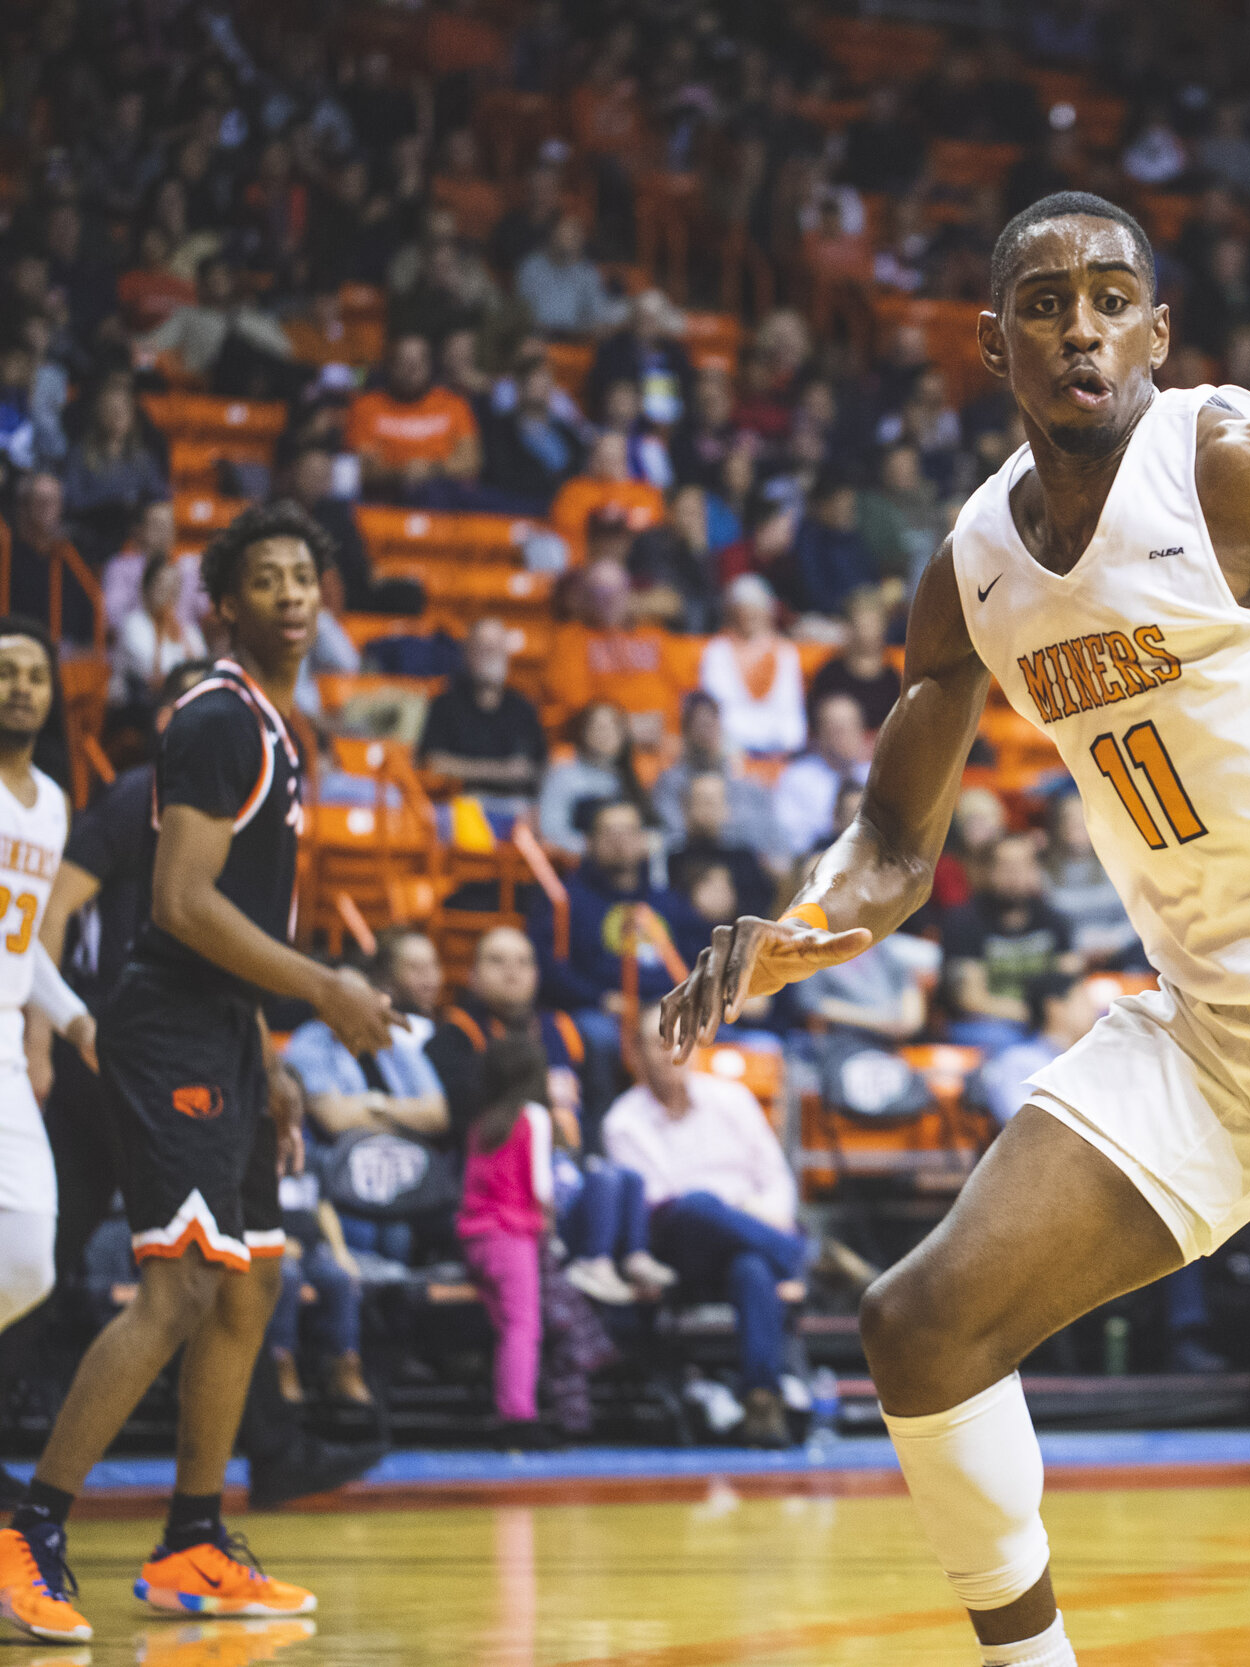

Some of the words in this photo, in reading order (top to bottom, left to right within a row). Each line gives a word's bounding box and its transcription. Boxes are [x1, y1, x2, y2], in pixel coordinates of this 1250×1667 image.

[1149, 546, 1184, 560] C-USA
[1017, 624, 1182, 724] MINERS
[1089, 719, 1209, 851] 11
